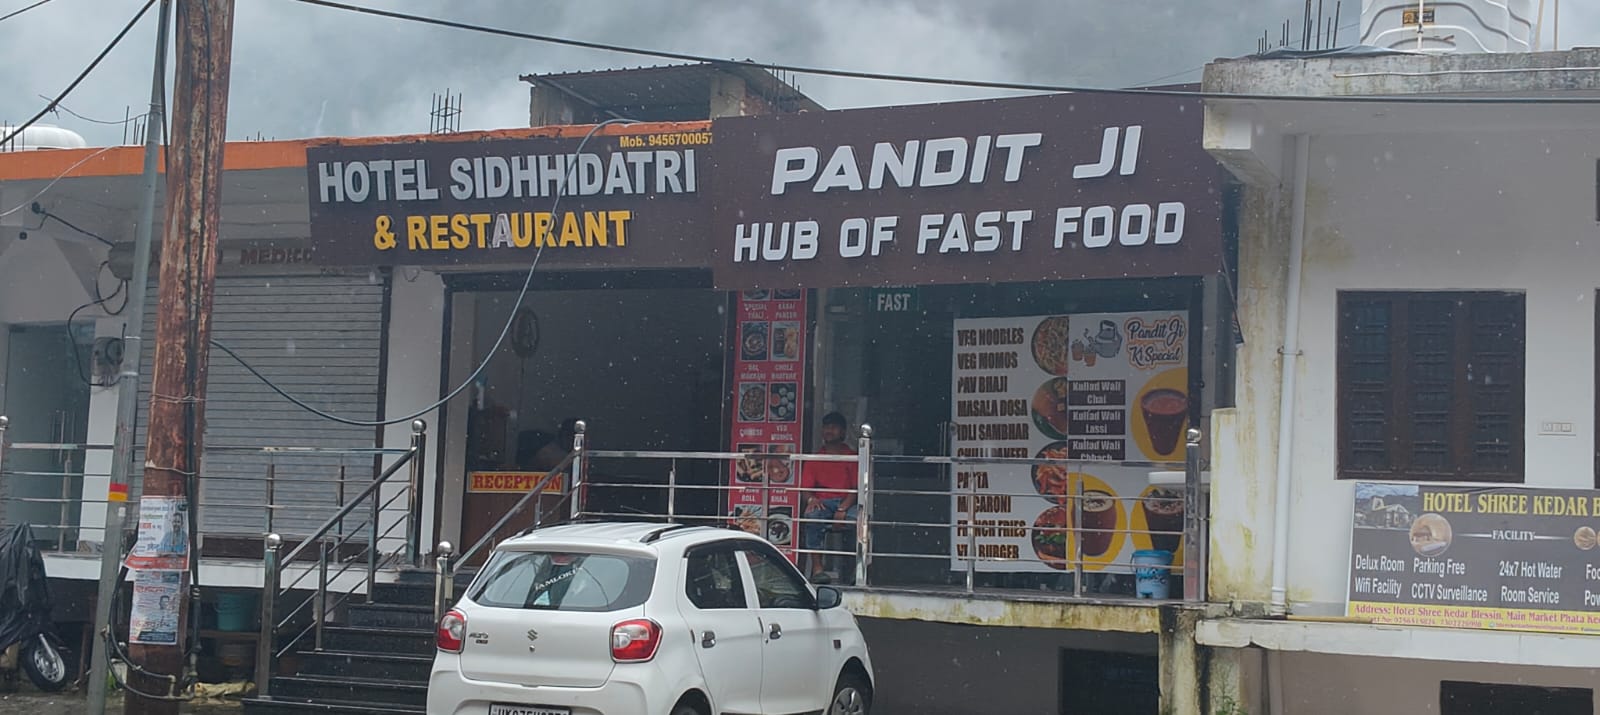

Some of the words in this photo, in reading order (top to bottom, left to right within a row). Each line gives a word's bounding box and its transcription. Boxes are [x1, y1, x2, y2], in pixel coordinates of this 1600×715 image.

[620, 136, 646, 148] Mob.
[649, 133, 712, 146] 9456700057
[771, 132, 1042, 195] PANDIT
[1072, 125, 1142, 179] JI
[318, 159, 438, 203] HOTEL
[450, 149, 697, 200] SIDHHIDATRI
[374, 215, 396, 249] &
[407, 210, 632, 250] RESTAURANT
[733, 220, 820, 263] HUB
[838, 215, 899, 258] OF
[917, 209, 1033, 254] FAST
[1053, 201, 1186, 249] FOOD
[877, 293, 911, 311] FAST
[957, 329, 977, 346] VEG
[979, 327, 1024, 346] NOODLES
[1128, 320, 1167, 340] Pandit
[957, 353, 977, 370] VEG
[979, 352, 1018, 370] MOMOS
[1145, 346, 1180, 365] Special
[957, 376, 977, 393] PAV
[979, 375, 1007, 393] BHAJI
[957, 400, 998, 417] MASALA
[1000, 399, 1028, 417] DOSA
[1087, 394, 1107, 404] Chai
[979, 423, 1029, 441] SAMBHAR
[1086, 423, 1108, 434] Lassi
[957, 472, 989, 489] PATA
[957, 496, 1012, 513] MCARONI
[1423, 492, 1473, 513] HOTEL
[1477, 494, 1529, 514] SHREE
[1533, 495, 1588, 516] KEDAR
[957, 520, 995, 537] FRNCH
[998, 520, 1026, 537] FRIES
[1492, 530, 1536, 541] FACILITY
[978, 544, 1019, 561] BURGER
[1355, 554, 1379, 571] Delux
[1380, 555, 1405, 571] Room
[1413, 557, 1445, 578] Parking
[1446, 558, 1466, 575] Free
[1499, 560, 1520, 577] 24x7
[1521, 561, 1536, 577] Hot
[1537, 562, 1562, 578] Water
[1355, 577, 1371, 593] Wifi
[1372, 578, 1402, 598] Facility
[1411, 583, 1436, 599] CCTV
[1436, 584, 1488, 602] Surveillance
[1501, 586, 1526, 602] Room
[1528, 587, 1560, 604] Service
[1354, 604, 1391, 614] Address:
[1393, 605, 1415, 615] Hotel
[1418, 607, 1441, 617] Shree
[1443, 608, 1468, 618] Kedar
[1507, 611, 1526, 621] Main
[1529, 612, 1557, 622] Market
